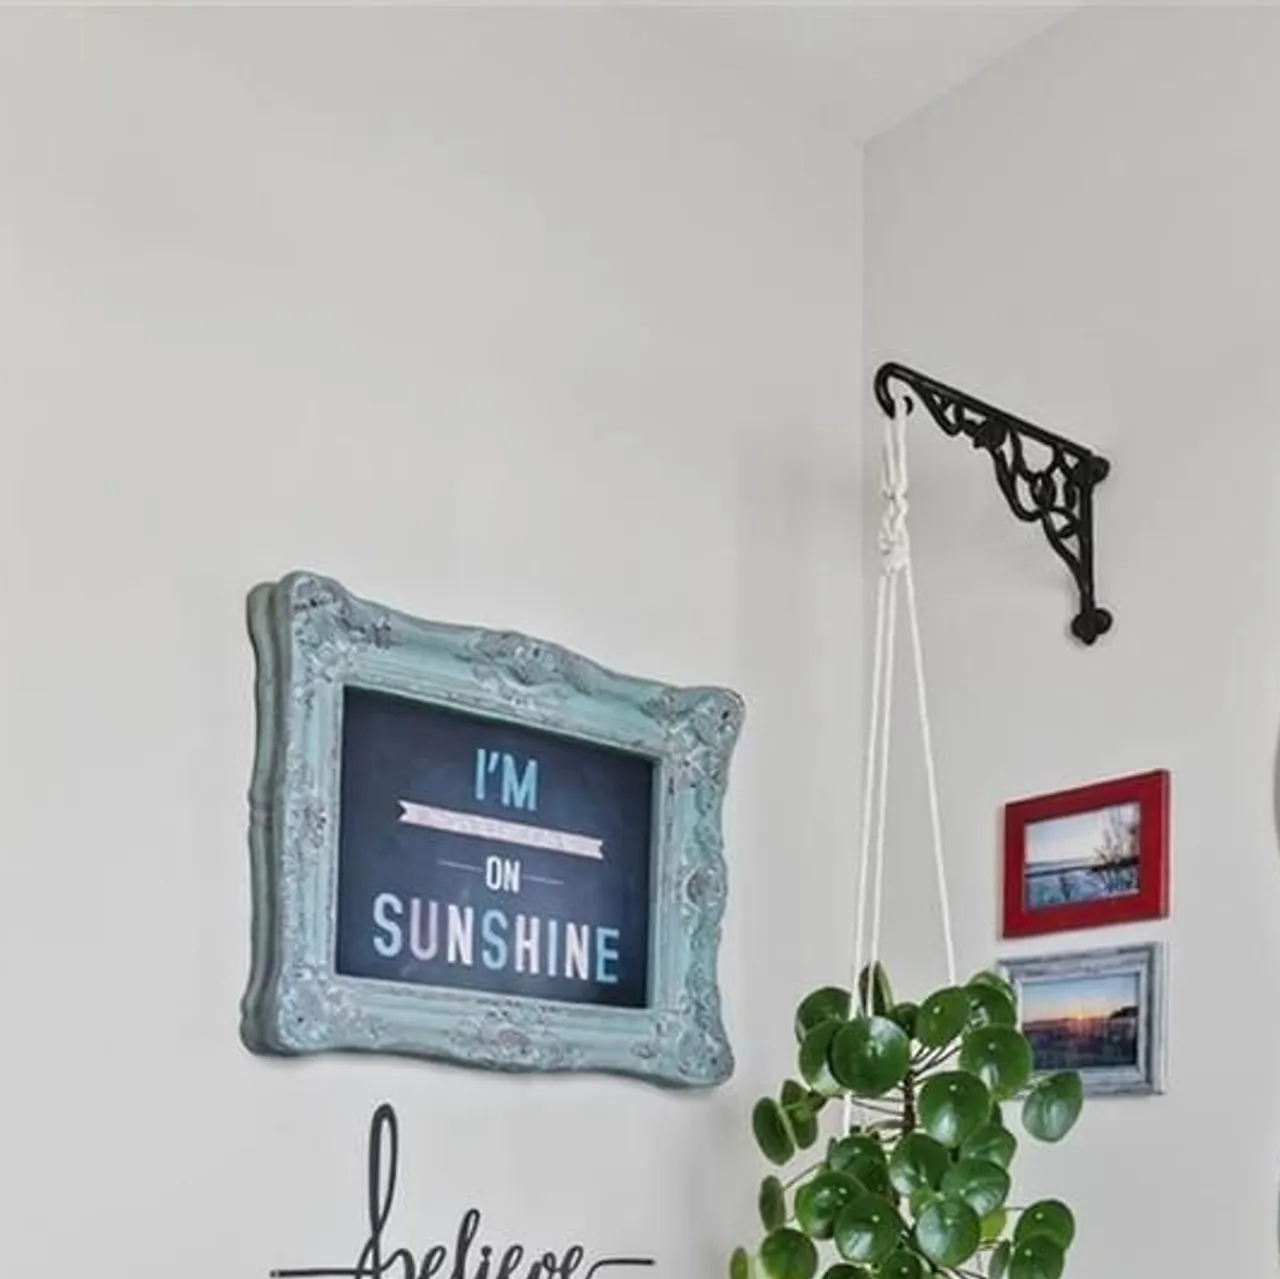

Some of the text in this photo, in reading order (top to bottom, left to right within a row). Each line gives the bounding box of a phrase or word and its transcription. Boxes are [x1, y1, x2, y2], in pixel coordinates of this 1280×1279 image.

[474, 748, 539, 811] I'M
[485, 855, 520, 893] ON
[373, 892, 621, 984] SUNSHINE
